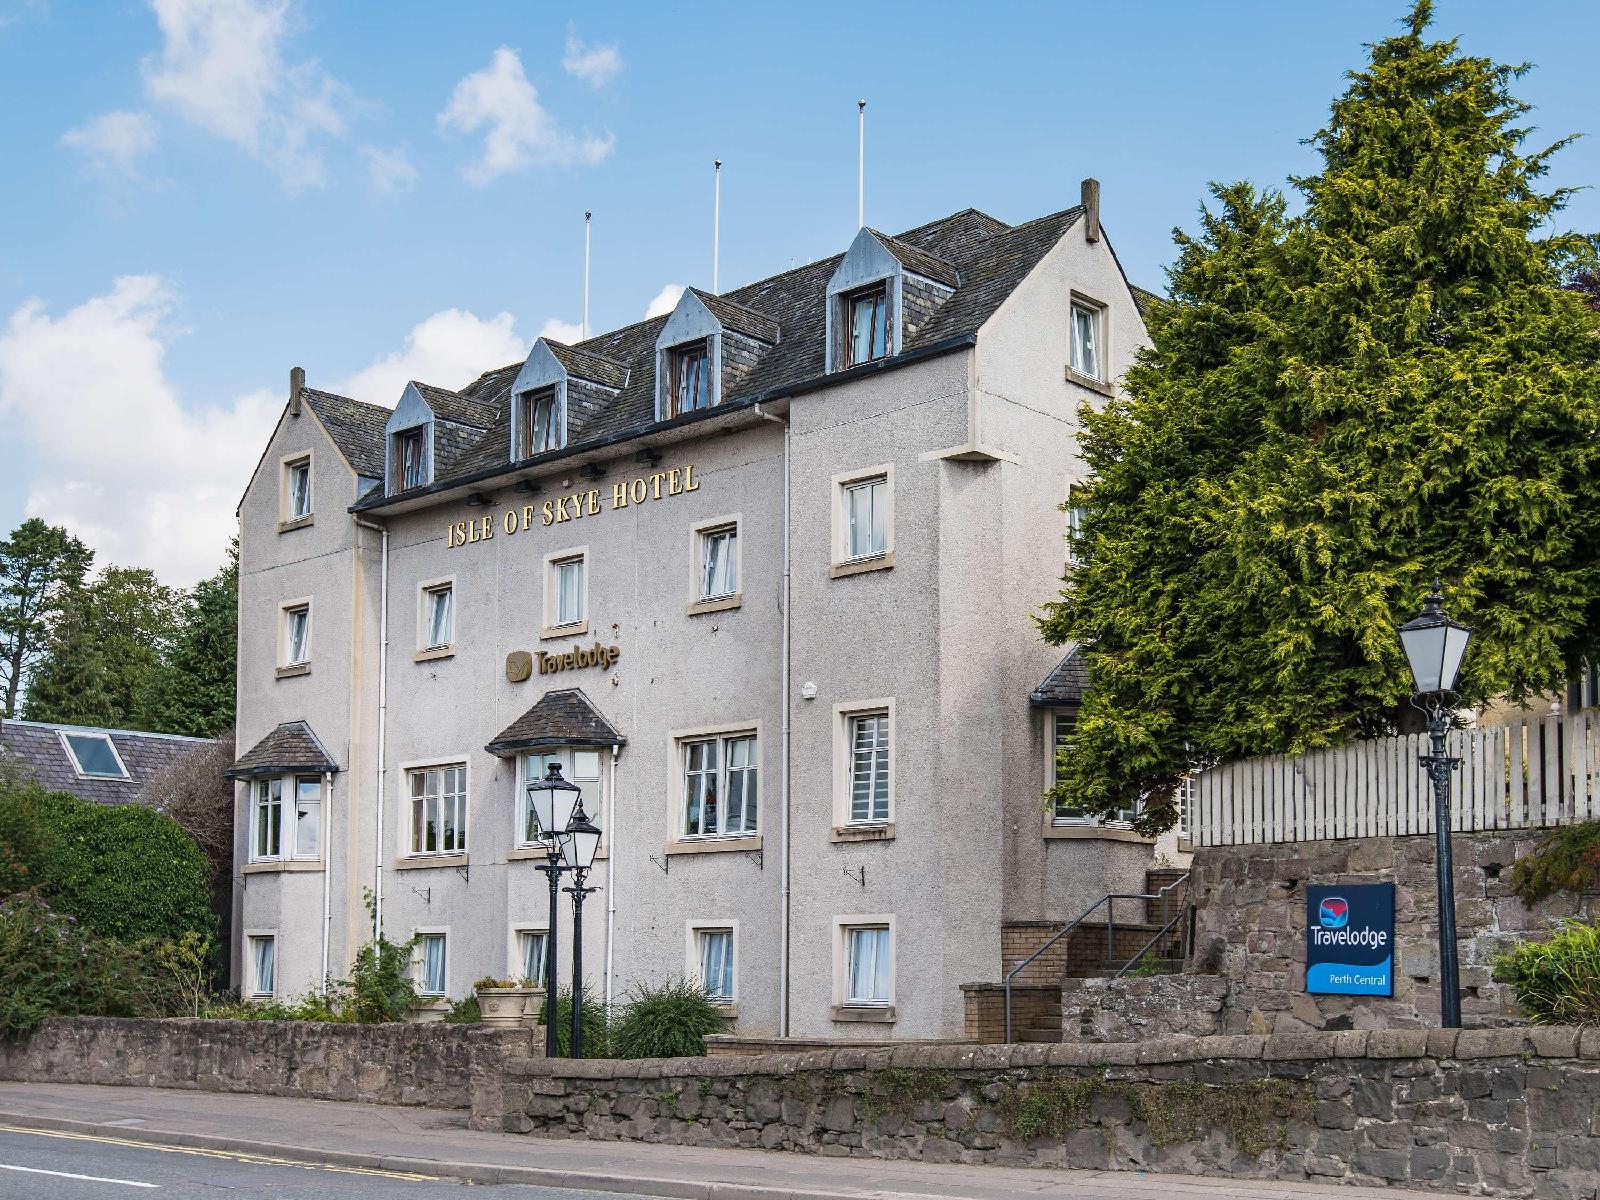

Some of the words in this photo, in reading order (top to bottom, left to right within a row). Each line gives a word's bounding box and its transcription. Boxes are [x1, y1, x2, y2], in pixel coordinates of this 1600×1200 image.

[447, 515, 494, 548] ISLE
[504, 505, 534, 535] OF
[542, 489, 601, 526] SKYE
[612, 465, 700, 509] HOTEL
[534, 641, 620, 675] Travelodge
[1310, 926, 1387, 949] Travelodge
[1330, 974, 1352, 984] Perth
[1353, 974, 1386, 986] Central
